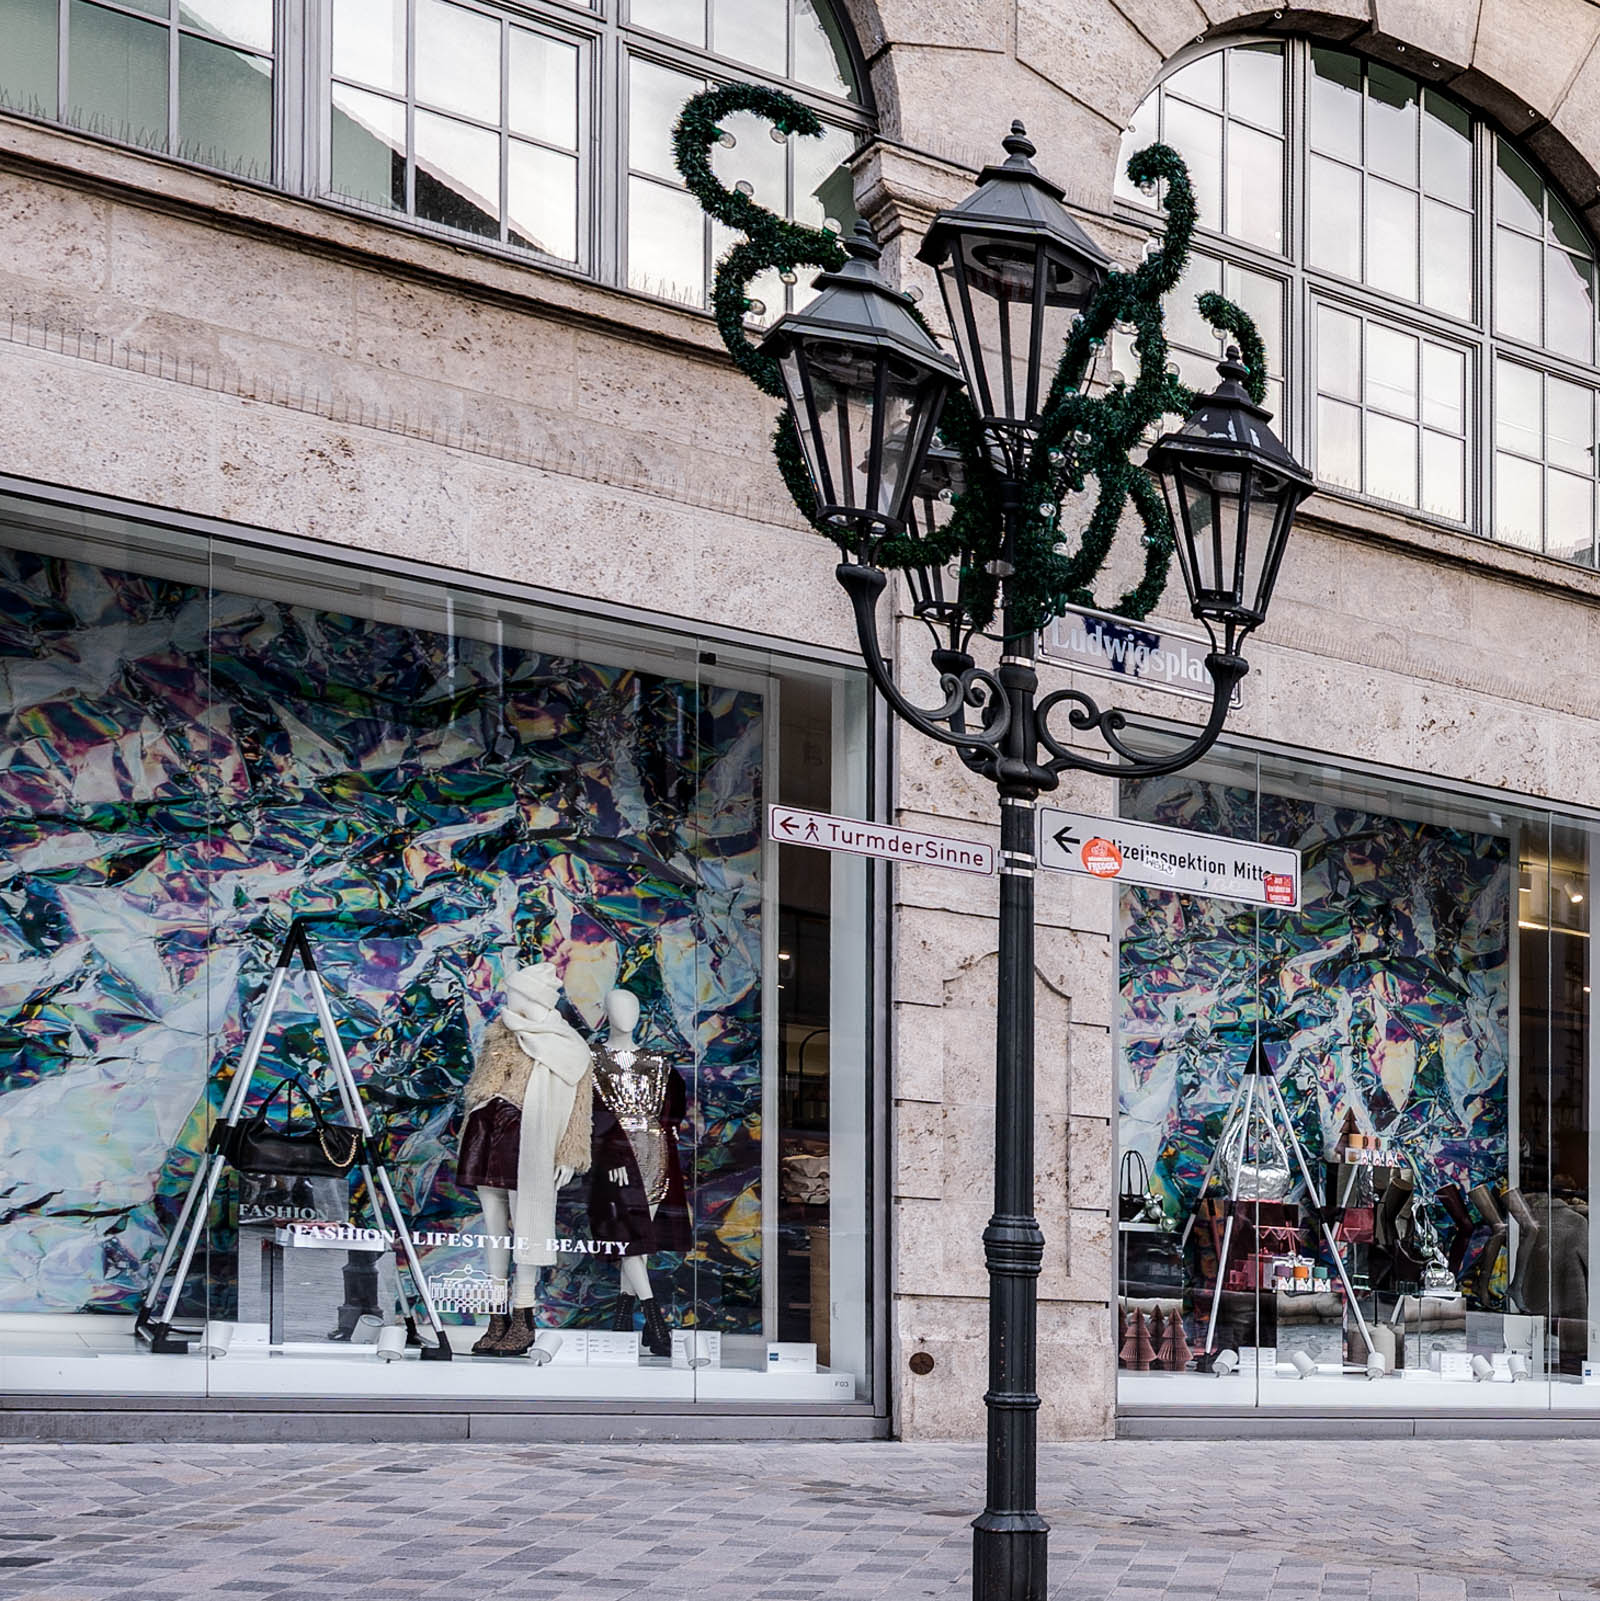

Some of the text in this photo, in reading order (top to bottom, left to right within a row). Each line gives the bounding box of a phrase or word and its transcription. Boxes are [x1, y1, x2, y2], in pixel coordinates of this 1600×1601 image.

[1051, 614, 1214, 686] Ludwigspla
[827, 822, 984, 867] TurmderSinne
[238, 1203, 329, 1222] FASHION
[296, 1223, 631, 1257] FASHION LIFESTYLE BEAUTY
